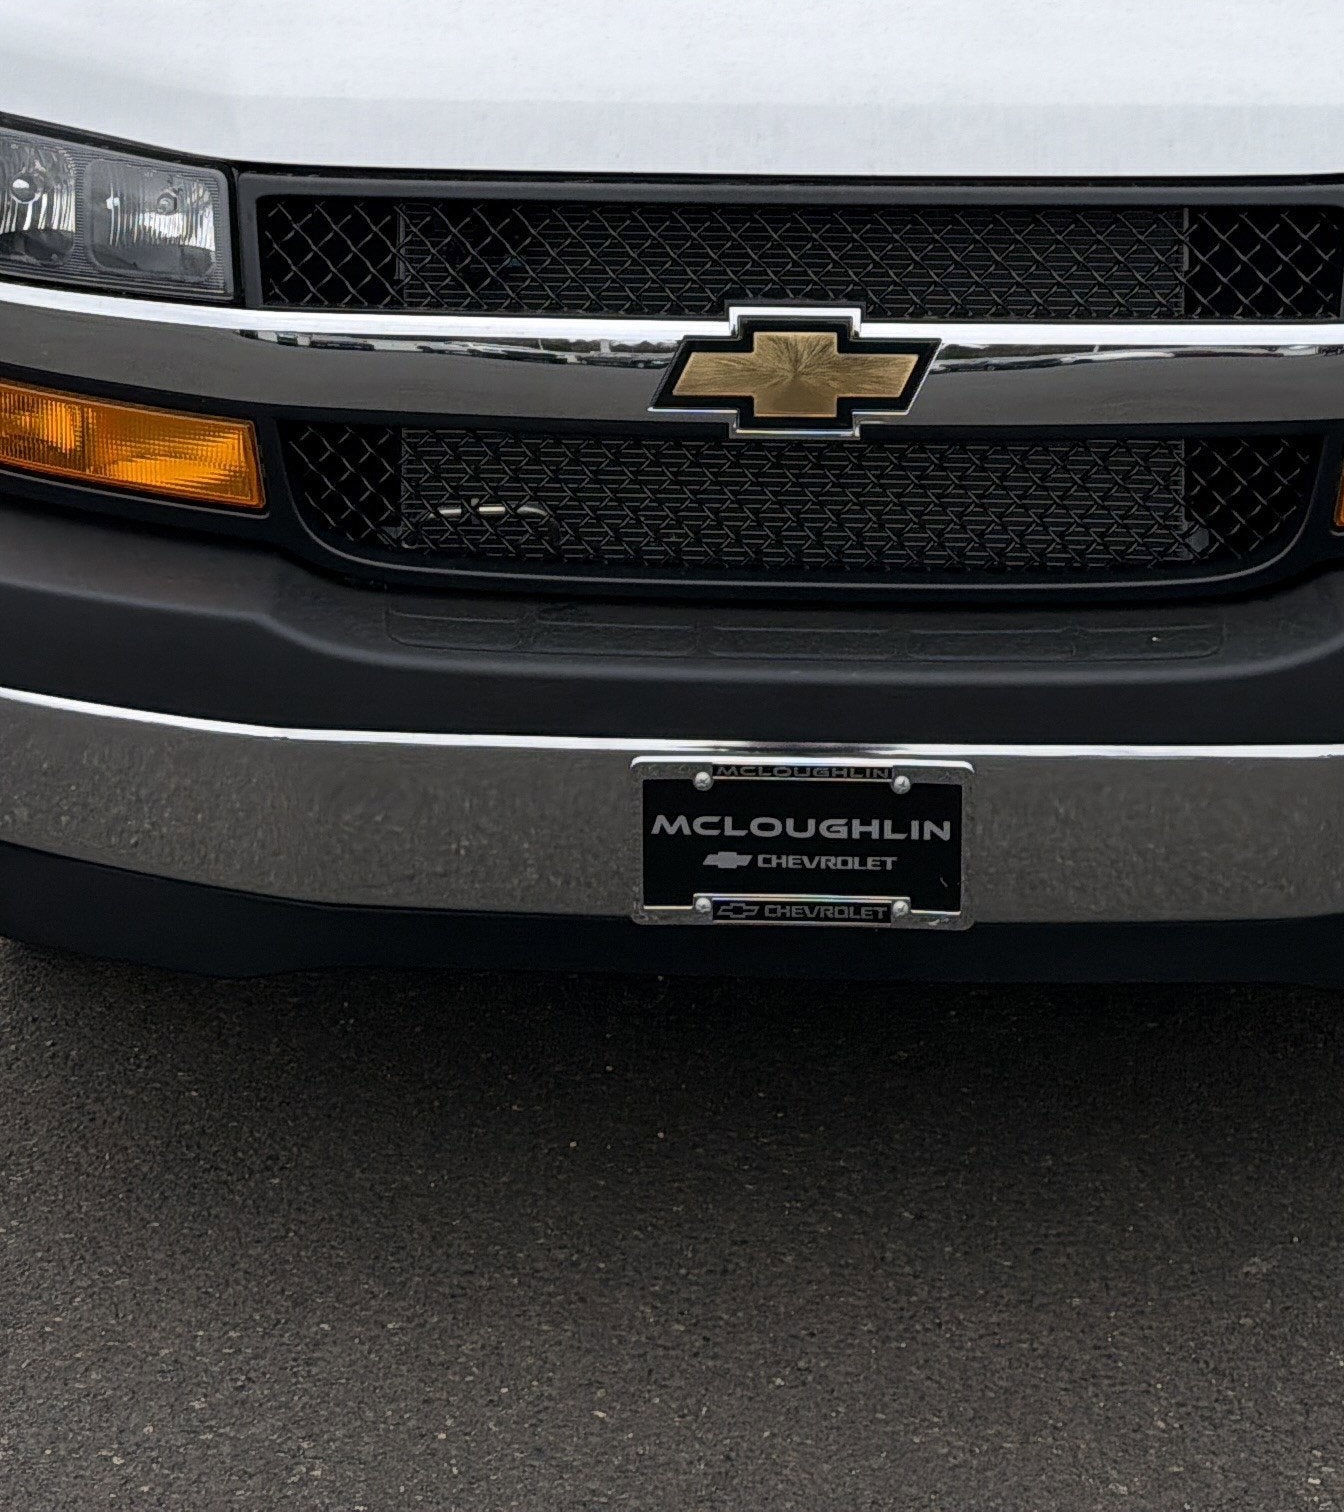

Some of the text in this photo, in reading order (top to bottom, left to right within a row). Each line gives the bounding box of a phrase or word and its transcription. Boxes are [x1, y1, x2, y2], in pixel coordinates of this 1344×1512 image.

[716, 765, 890, 779] MCLOUGHLIN
[651, 814, 951, 842] MCLOUGHLIN
[756, 854, 898, 871] CHEVROLET
[764, 904, 888, 919] CHEVROLET
